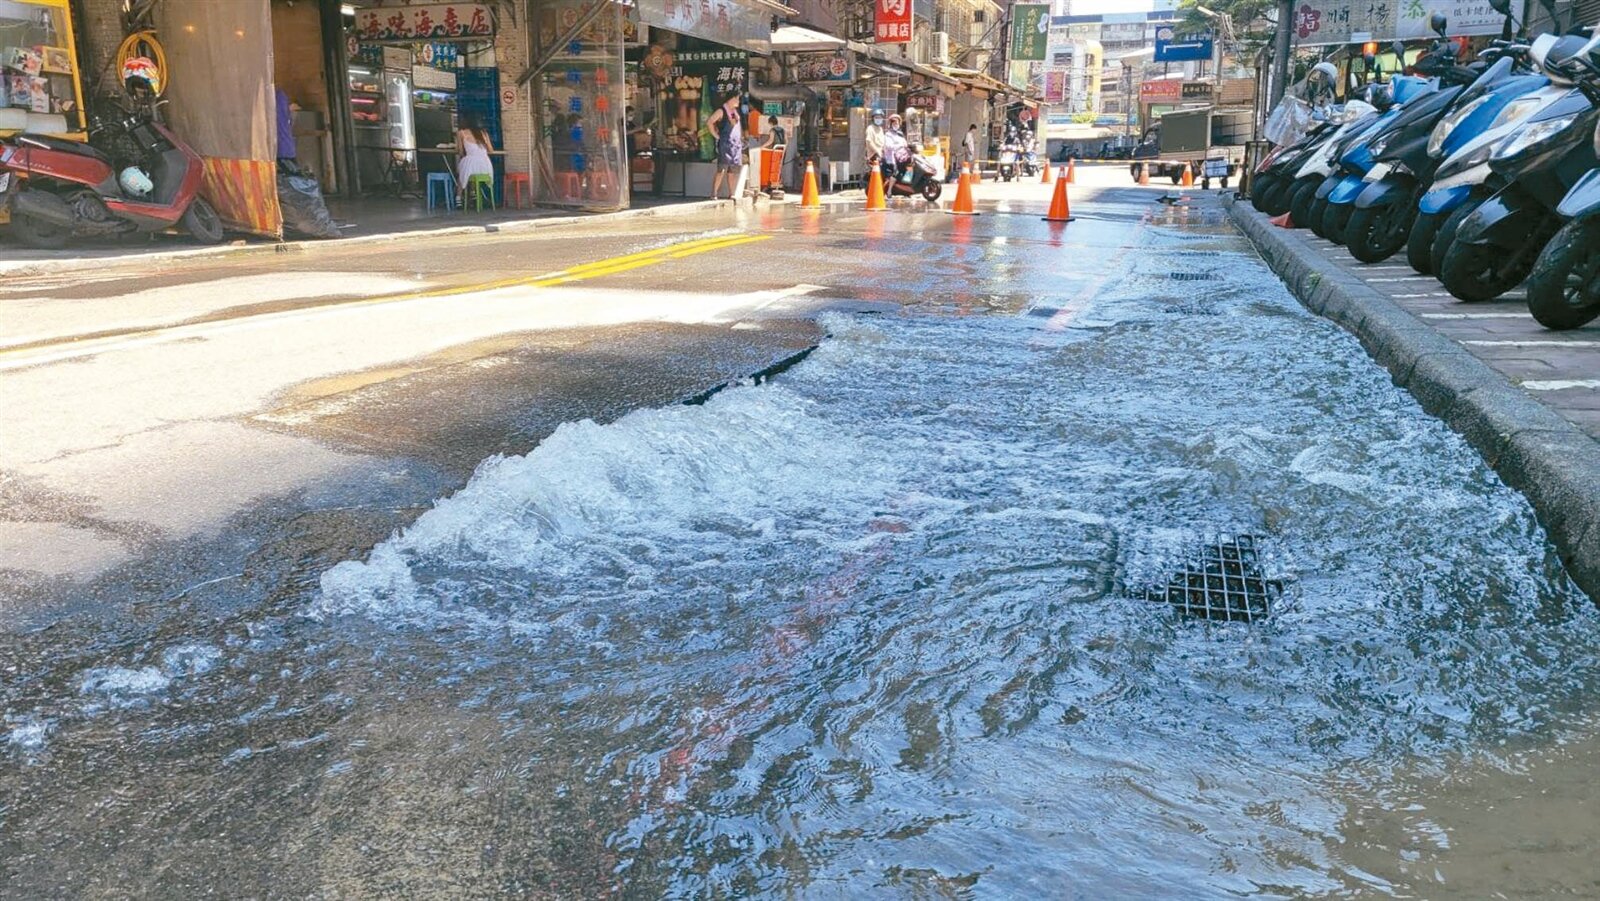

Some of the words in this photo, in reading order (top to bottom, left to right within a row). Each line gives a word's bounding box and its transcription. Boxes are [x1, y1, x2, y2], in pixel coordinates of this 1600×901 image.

[878, 23, 909, 38] 專賣店
[717, 66, 744, 80] 海味
